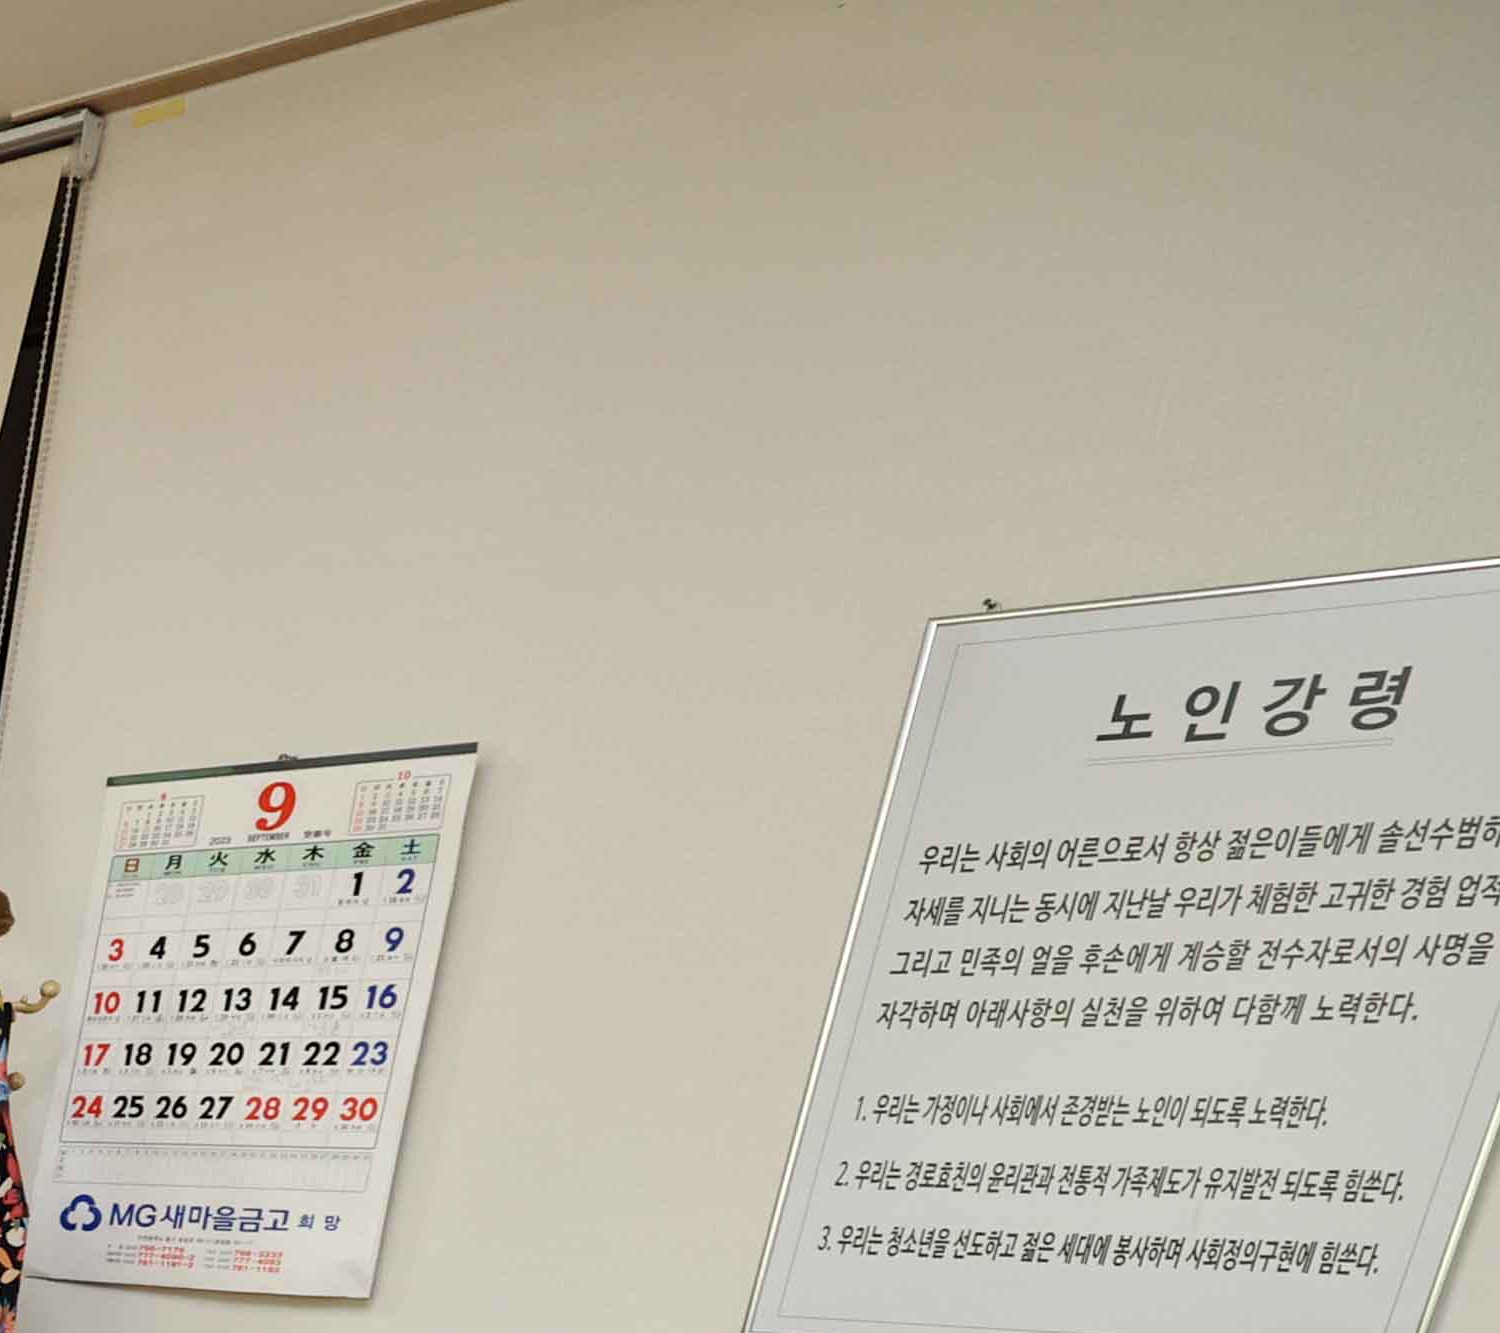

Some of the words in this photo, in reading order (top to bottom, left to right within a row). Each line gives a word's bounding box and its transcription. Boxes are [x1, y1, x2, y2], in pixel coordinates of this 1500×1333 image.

[1095, 665, 1413, 742] 노인강령
[255, 782, 296, 831] 9
[124, 857, 140, 873] 日
[165, 854, 182, 870] 月
[208, 851, 229, 867] 火
[254, 848, 276, 864] 水
[302, 845, 324, 861] 木
[353, 841, 375, 859] 金
[401, 838, 420, 855] 土
[919, 843, 980, 874] 우리는
[985, 838, 1052, 871] 사회의
[1056, 833, 1169, 868] 어른으로서
[1174, 830, 1222, 863] 항상
[1226, 821, 1375, 861] 젊은이들에게
[353, 871, 364, 897] 1
[395, 868, 415, 895] 2
[904, 895, 964, 927] 자세를
[968, 892, 1030, 924] 지니는
[1034, 890, 1100, 923] 동시에
[1103, 887, 1171, 920] 지난날
[1174, 884, 1244, 918] 우리가
[1246, 880, 1318, 915] 체험한
[1320, 877, 1396, 912] 고귀한
[1400, 875, 1451, 909] 경험
[108, 938, 124, 962] 3
[149, 935, 167, 960] 4
[192, 934, 210, 959] 5
[238, 932, 257, 957] 6
[285, 930, 307, 956] 7
[334, 928, 355, 954] 8
[385, 926, 405, 952] 9
[889, 948, 953, 978] 그리고
[959, 945, 1025, 977] 민족의
[1030, 944, 1074, 976] 얼을
[1079, 941, 1174, 975] 후손에게
[1178, 939, 1251, 973] 계승할
[1256, 934, 1409, 971] 전수자로서의
[1412, 931, 1494, 968] 사명을
[94, 991, 121, 1015] 10
[136, 989, 162, 1014] 11
[178, 988, 207, 1013] 12
[223, 987, 253, 1012] 13
[270, 986, 300, 1011] 14
[318, 985, 348, 1011] 15
[367, 983, 397, 1009] 16
[876, 999, 961, 1030] 자각하며
[966, 997, 1075, 1029] 아래사항의
[1080, 996, 1148, 1028] 실천을
[1154, 994, 1226, 1027] 위하여
[1232, 993, 1307, 1026] 다함께
[1310, 991, 1419, 1025] 노력한다.
[84, 1043, 111, 1067] 17
[124, 1042, 153, 1067] 18
[167, 1042, 197, 1066] 19
[208, 1042, 245, 1066] 20
[258, 1041, 290, 1066] 21
[302, 1041, 341, 1066] 22
[351, 1041, 389, 1066] 23
[71, 1095, 103, 1119] 24
[112, 1095, 144, 1119] 25
[155, 1095, 188, 1119] 26
[199, 1095, 234, 1120] 27
[245, 1096, 281, 1121] 28
[292, 1097, 329, 1121] 29
[340, 1097, 378, 1121] 30
[854, 1095, 867, 1121] 1.
[872, 1093, 920, 1125] 우리는
[922, 1093, 988, 1126] 가정이나
[989, 1093, 1060, 1127] 사회에서
[1060, 1094, 1130, 1128] 존경받는
[1132, 1095, 1189, 1127] 노인이
[1190, 1095, 1247, 1128] 되도록
[1248, 1095, 1327, 1129] 노력한다.
[834, 1161, 849, 1187] 2.
[855, 1160, 901, 1191] 우리는
[904, 1160, 988, 1193] 경로효친의
[987, 1162, 1056, 1195] 윤리관과
[1058, 1163, 1111, 1197] 전통적
[1112, 1165, 1202, 1198] 가족제도가
[1204, 1167, 1280, 1200] 유지발전
[1280, 1168, 1340, 1202] 되도록
[1342, 1169, 1404, 1204] 힘쓴다.
[817, 1225, 831, 1251] 3.
[837, 1225, 883, 1256] 우리는
[886, 1227, 950, 1259] 청소년을
[952, 1229, 1019, 1261] 선도하고
[1020, 1231, 1056, 1263] 젊은
[1057, 1233, 1113, 1266] 세대에
[1112, 1235, 1186, 1269] 봉사하며
[1186, 1238, 1318, 1274] 사회정의구현에
[1318, 1241, 1379, 1277] 힘쓴다.
